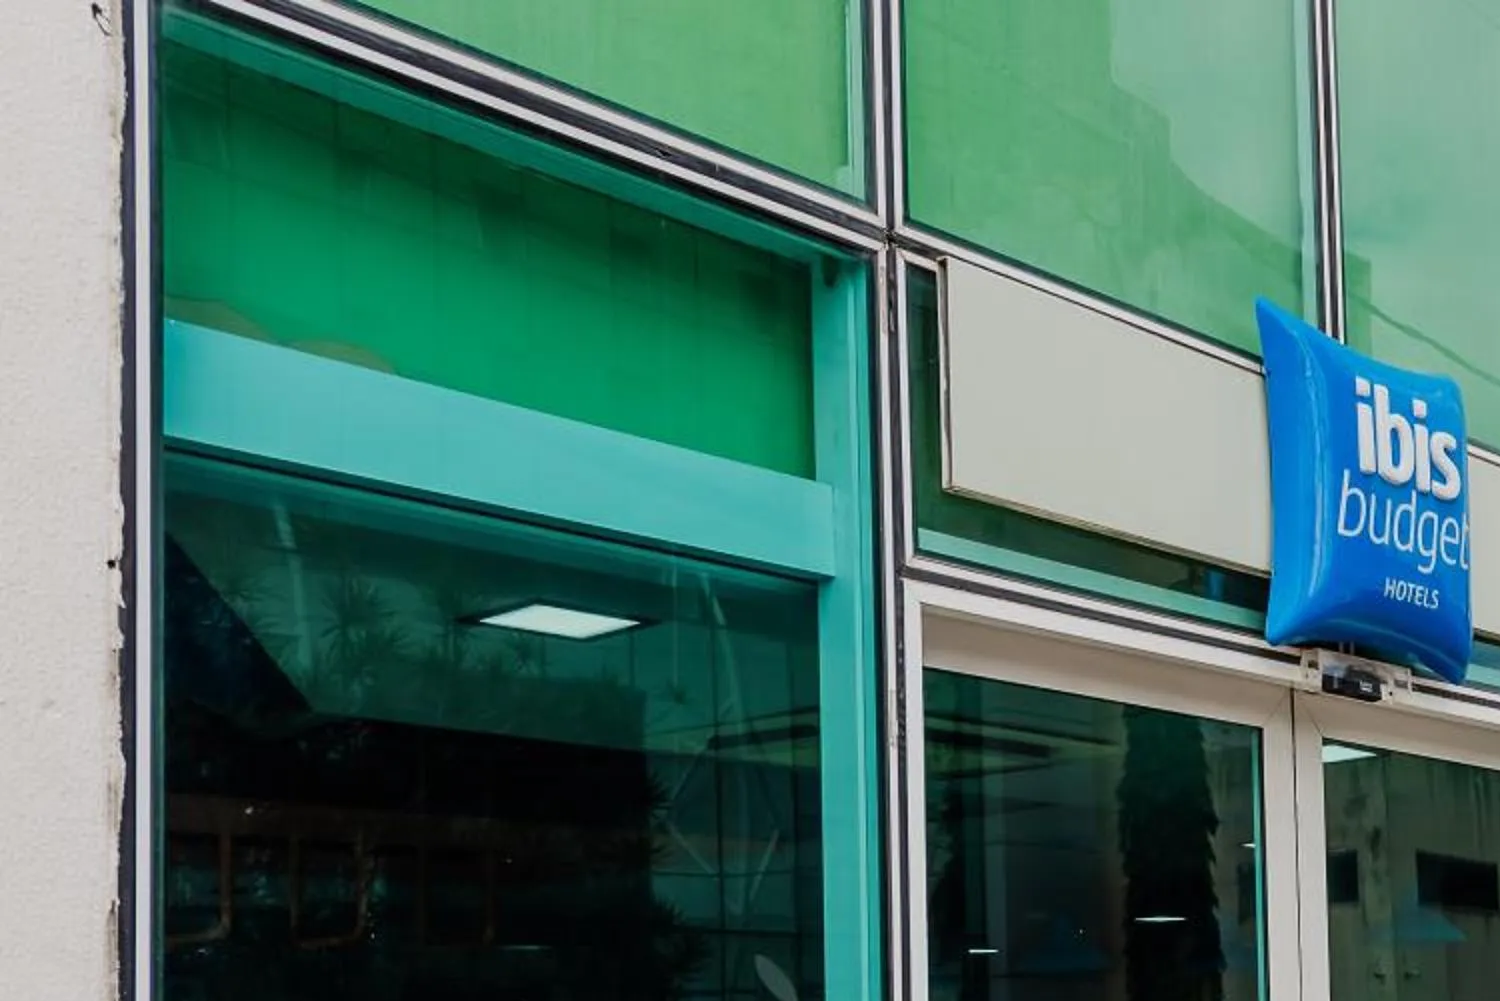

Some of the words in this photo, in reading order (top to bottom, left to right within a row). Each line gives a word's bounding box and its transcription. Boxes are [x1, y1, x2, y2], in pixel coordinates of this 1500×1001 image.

[1355, 375, 1461, 500] ibis
[1338, 468, 1469, 574] budget
[1383, 576, 1439, 609] HOTELS
